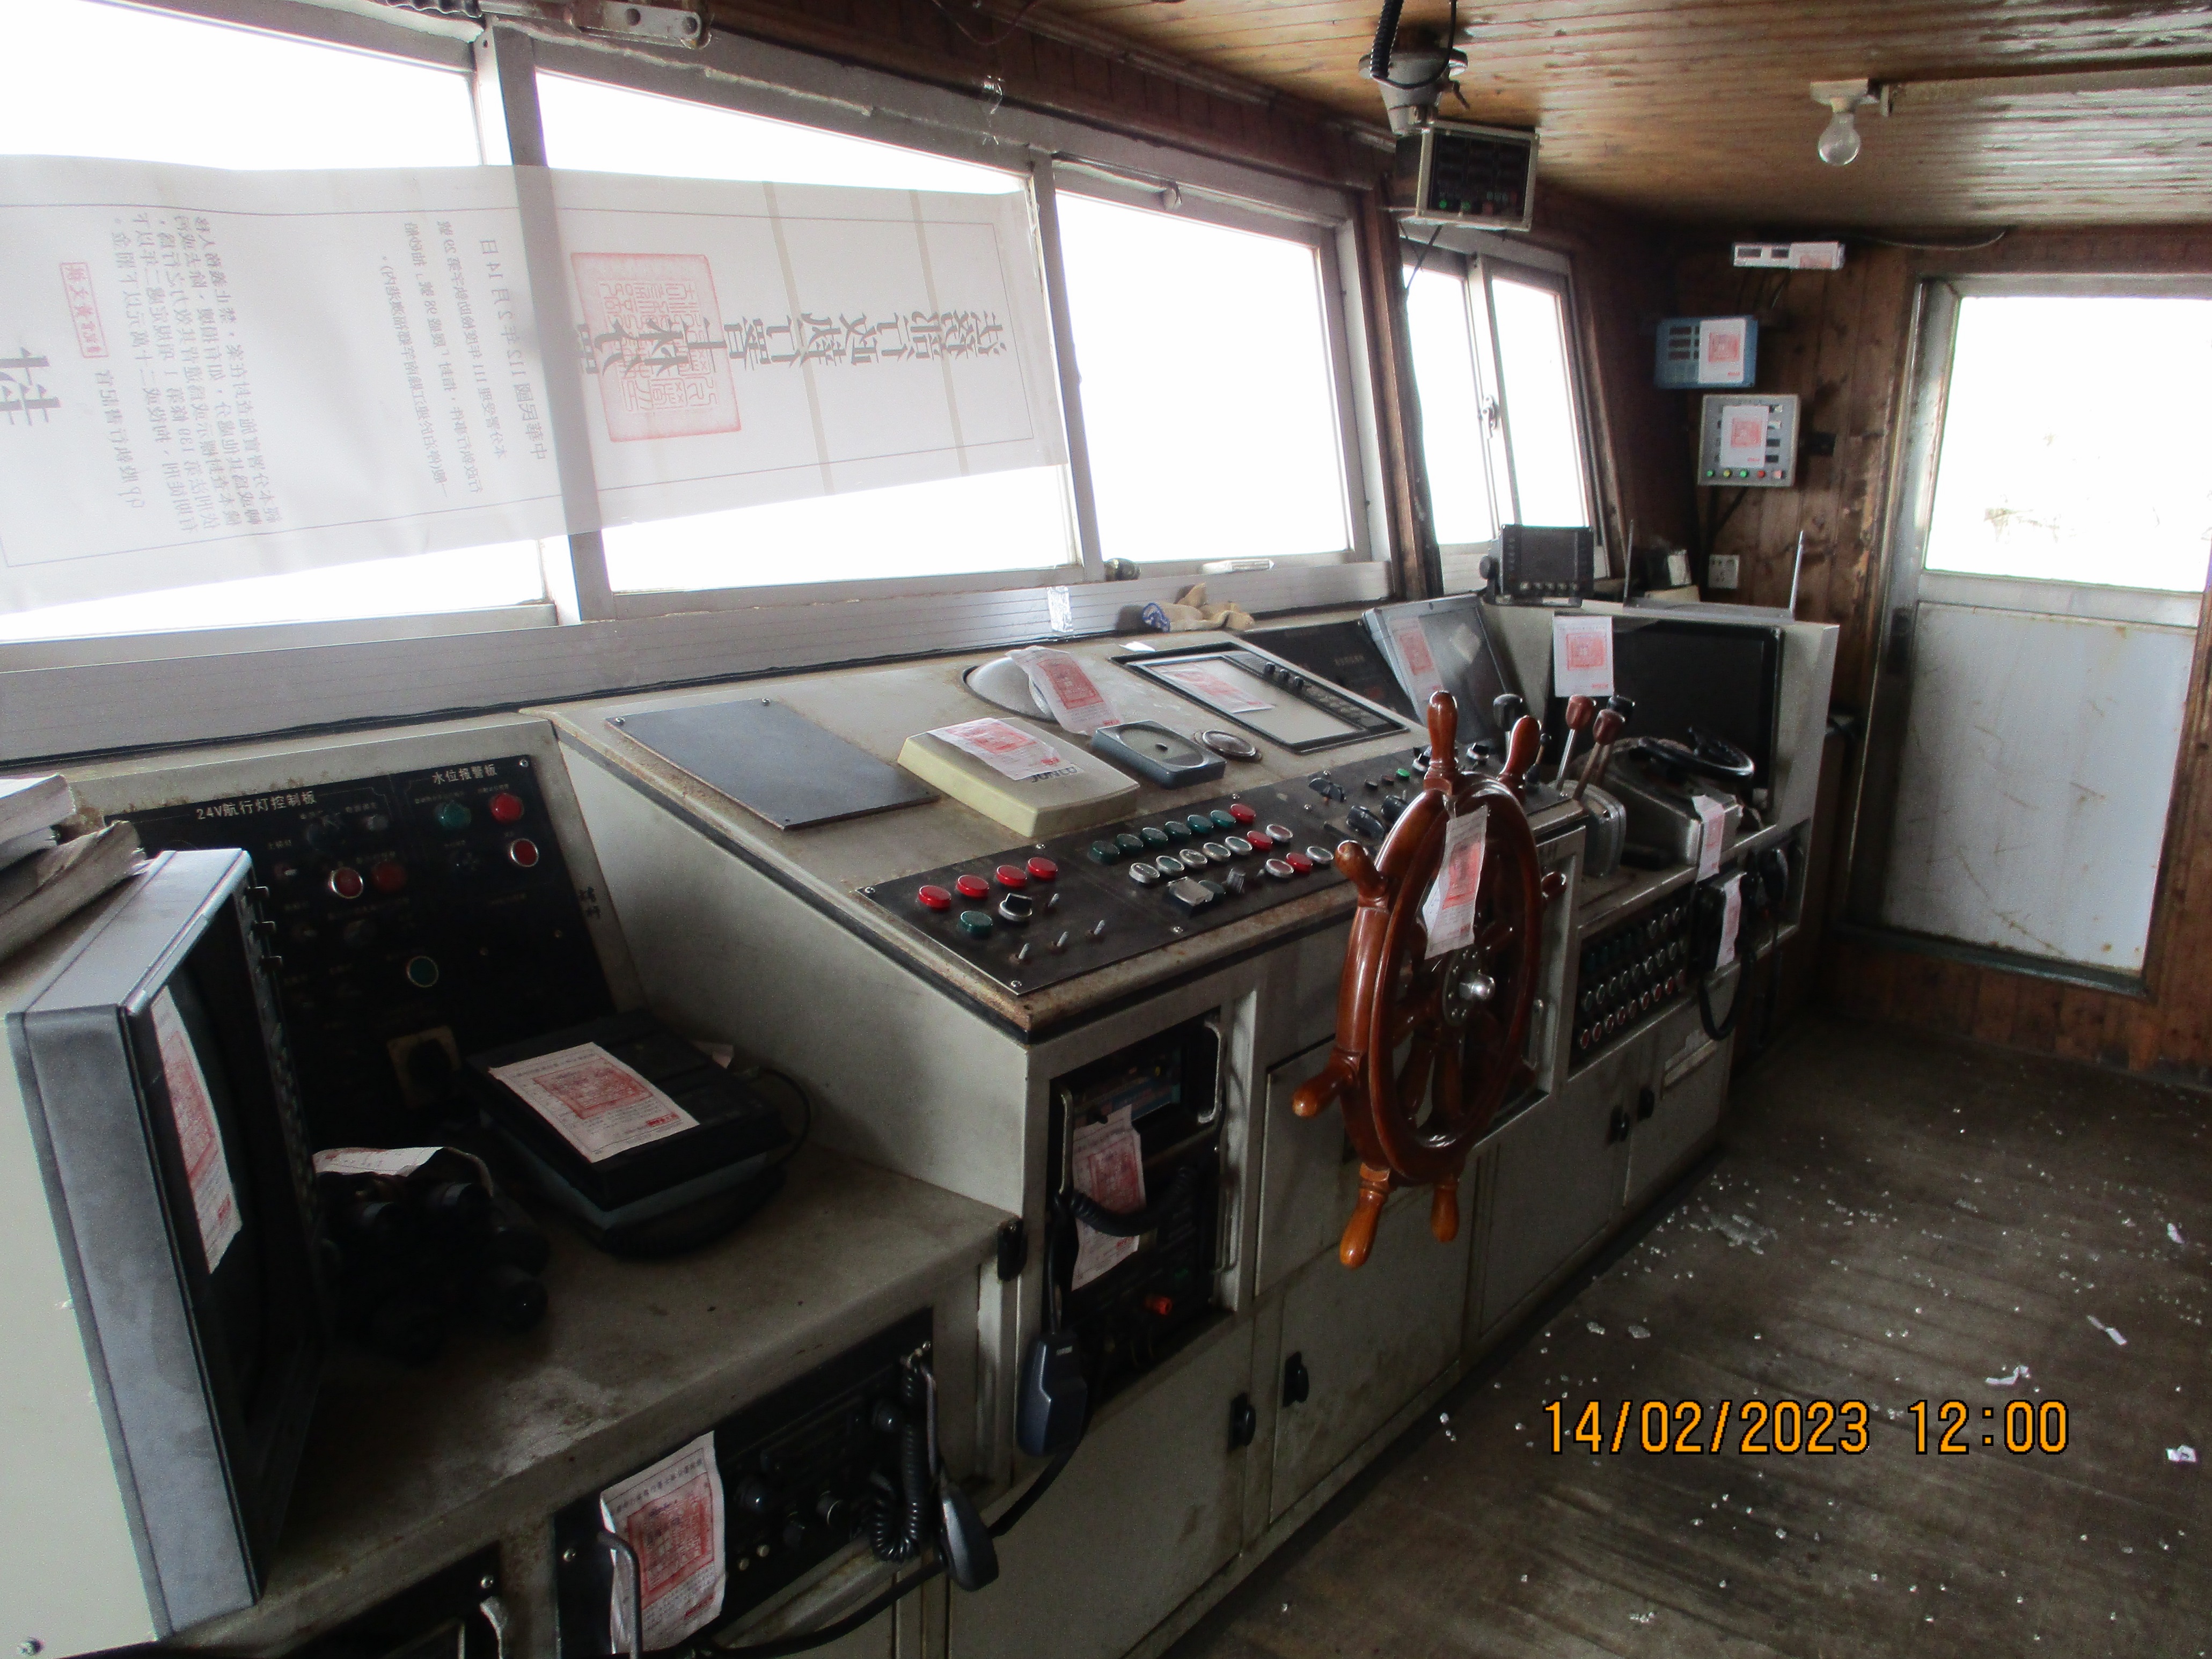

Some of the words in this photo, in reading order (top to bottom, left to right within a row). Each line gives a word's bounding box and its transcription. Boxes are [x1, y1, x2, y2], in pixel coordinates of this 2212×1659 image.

[196, 791, 317, 820] 24V航行灯控制板
